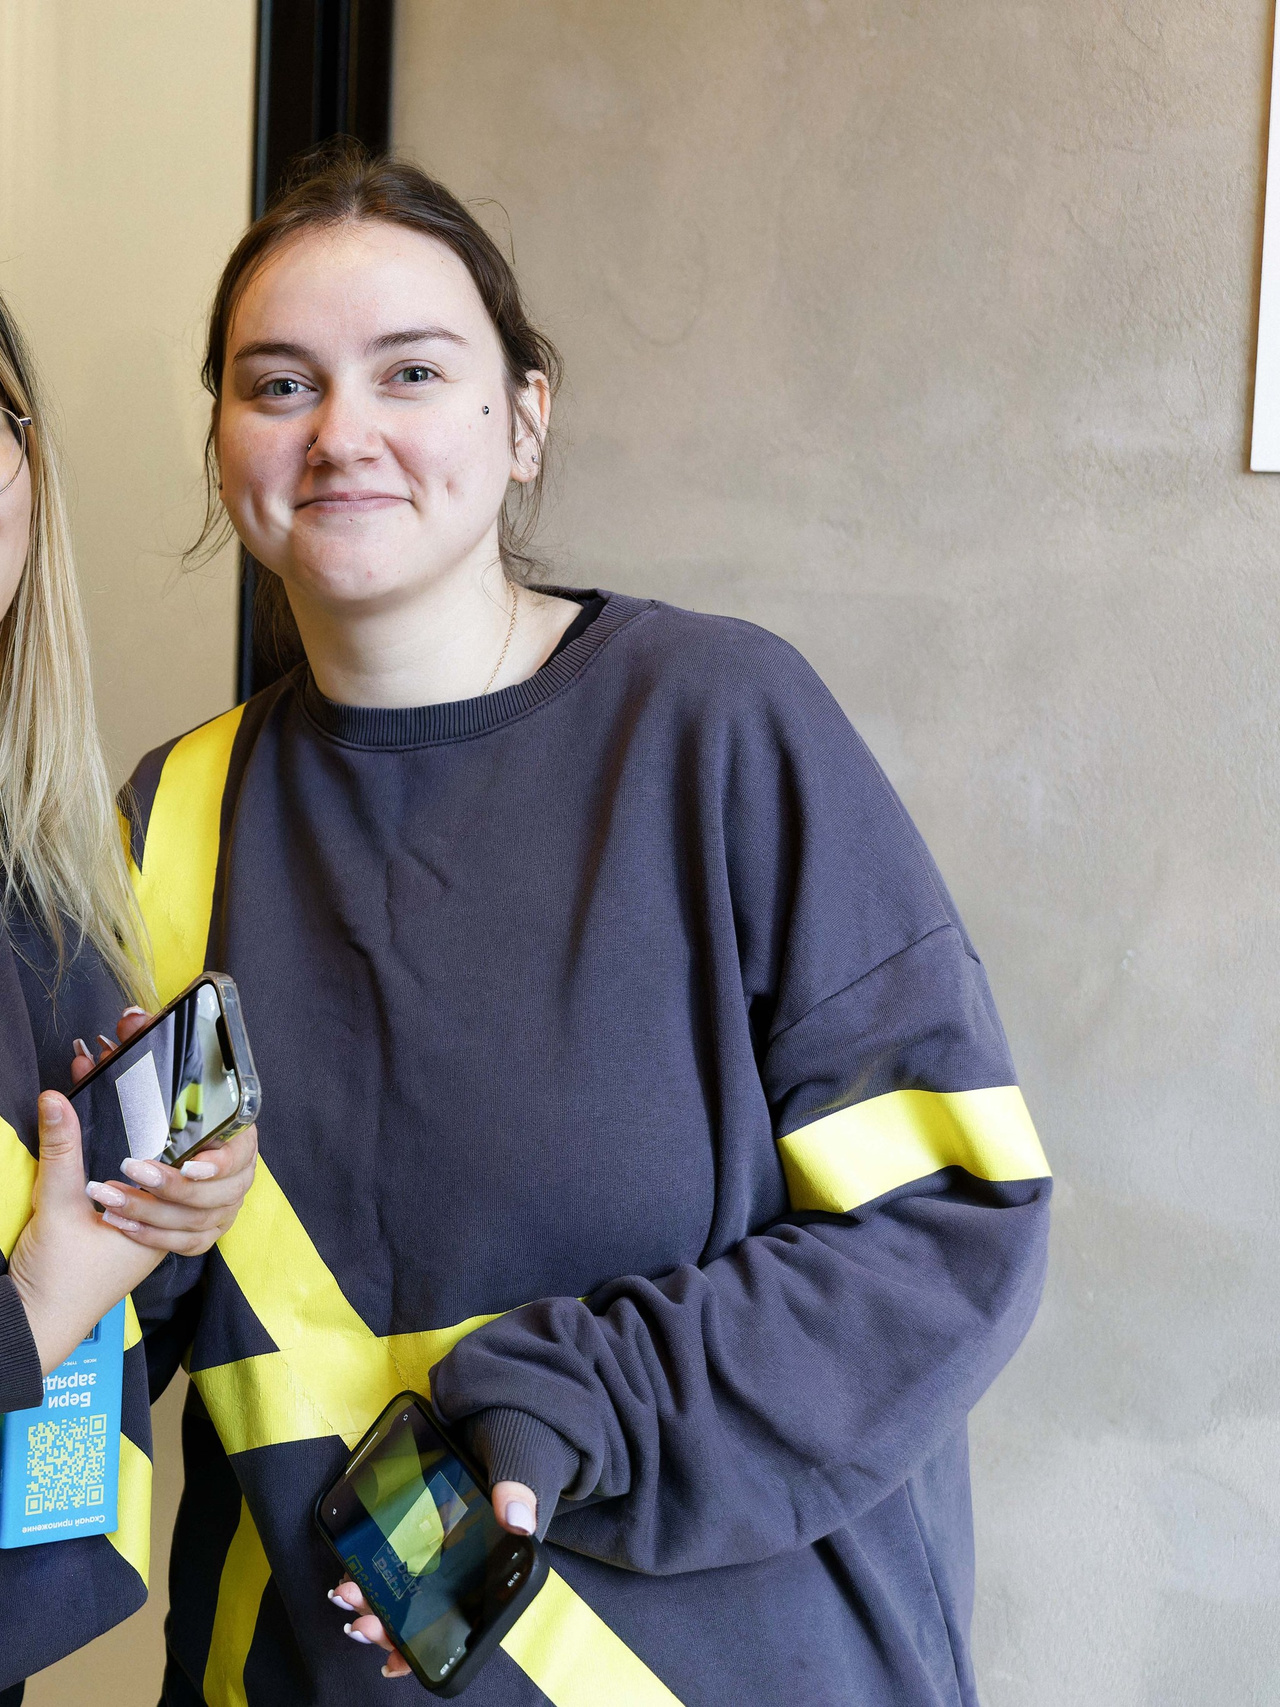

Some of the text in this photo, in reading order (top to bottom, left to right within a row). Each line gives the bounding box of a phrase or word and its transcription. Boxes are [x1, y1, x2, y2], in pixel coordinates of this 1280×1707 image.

[48, 1391, 92, 1409] Бери
[22, 1515, 106, 1533] Скачай приложение
